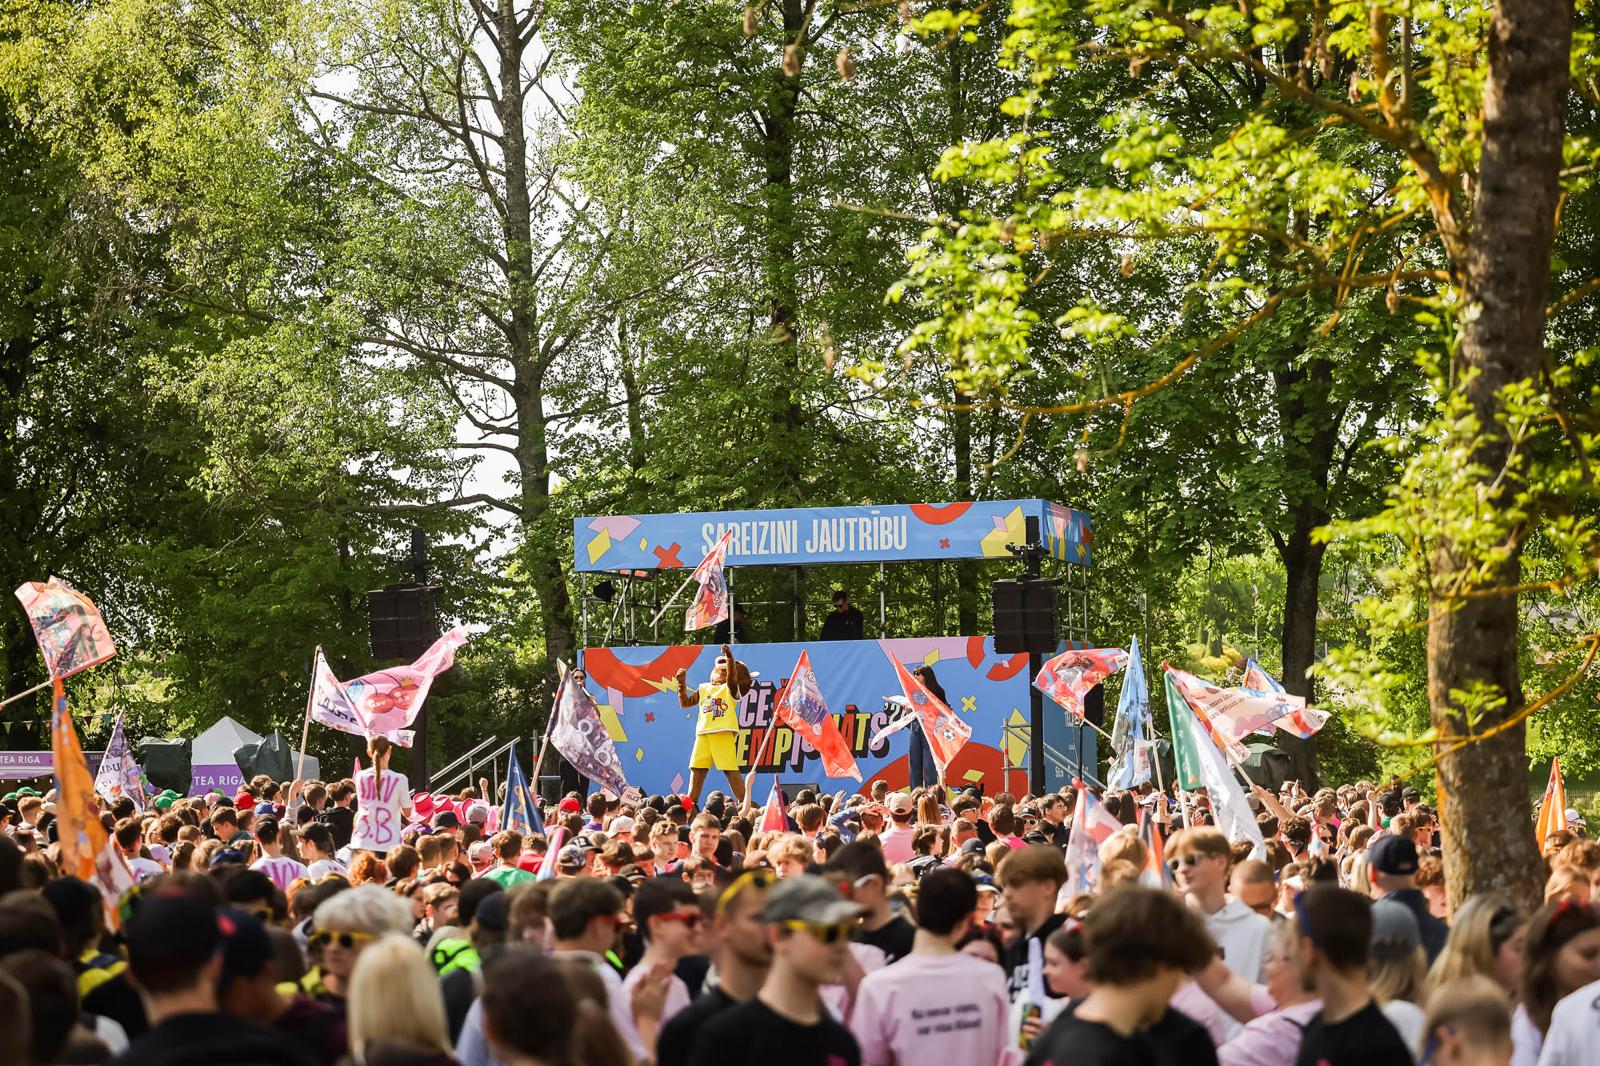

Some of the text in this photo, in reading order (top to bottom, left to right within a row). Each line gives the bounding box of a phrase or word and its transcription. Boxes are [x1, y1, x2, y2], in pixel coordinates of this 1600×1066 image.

[805, 510, 907, 554] JAUTRĪBU
[18, 755, 40, 764] RIGA
[194, 775, 247, 786] TEA RIGA
